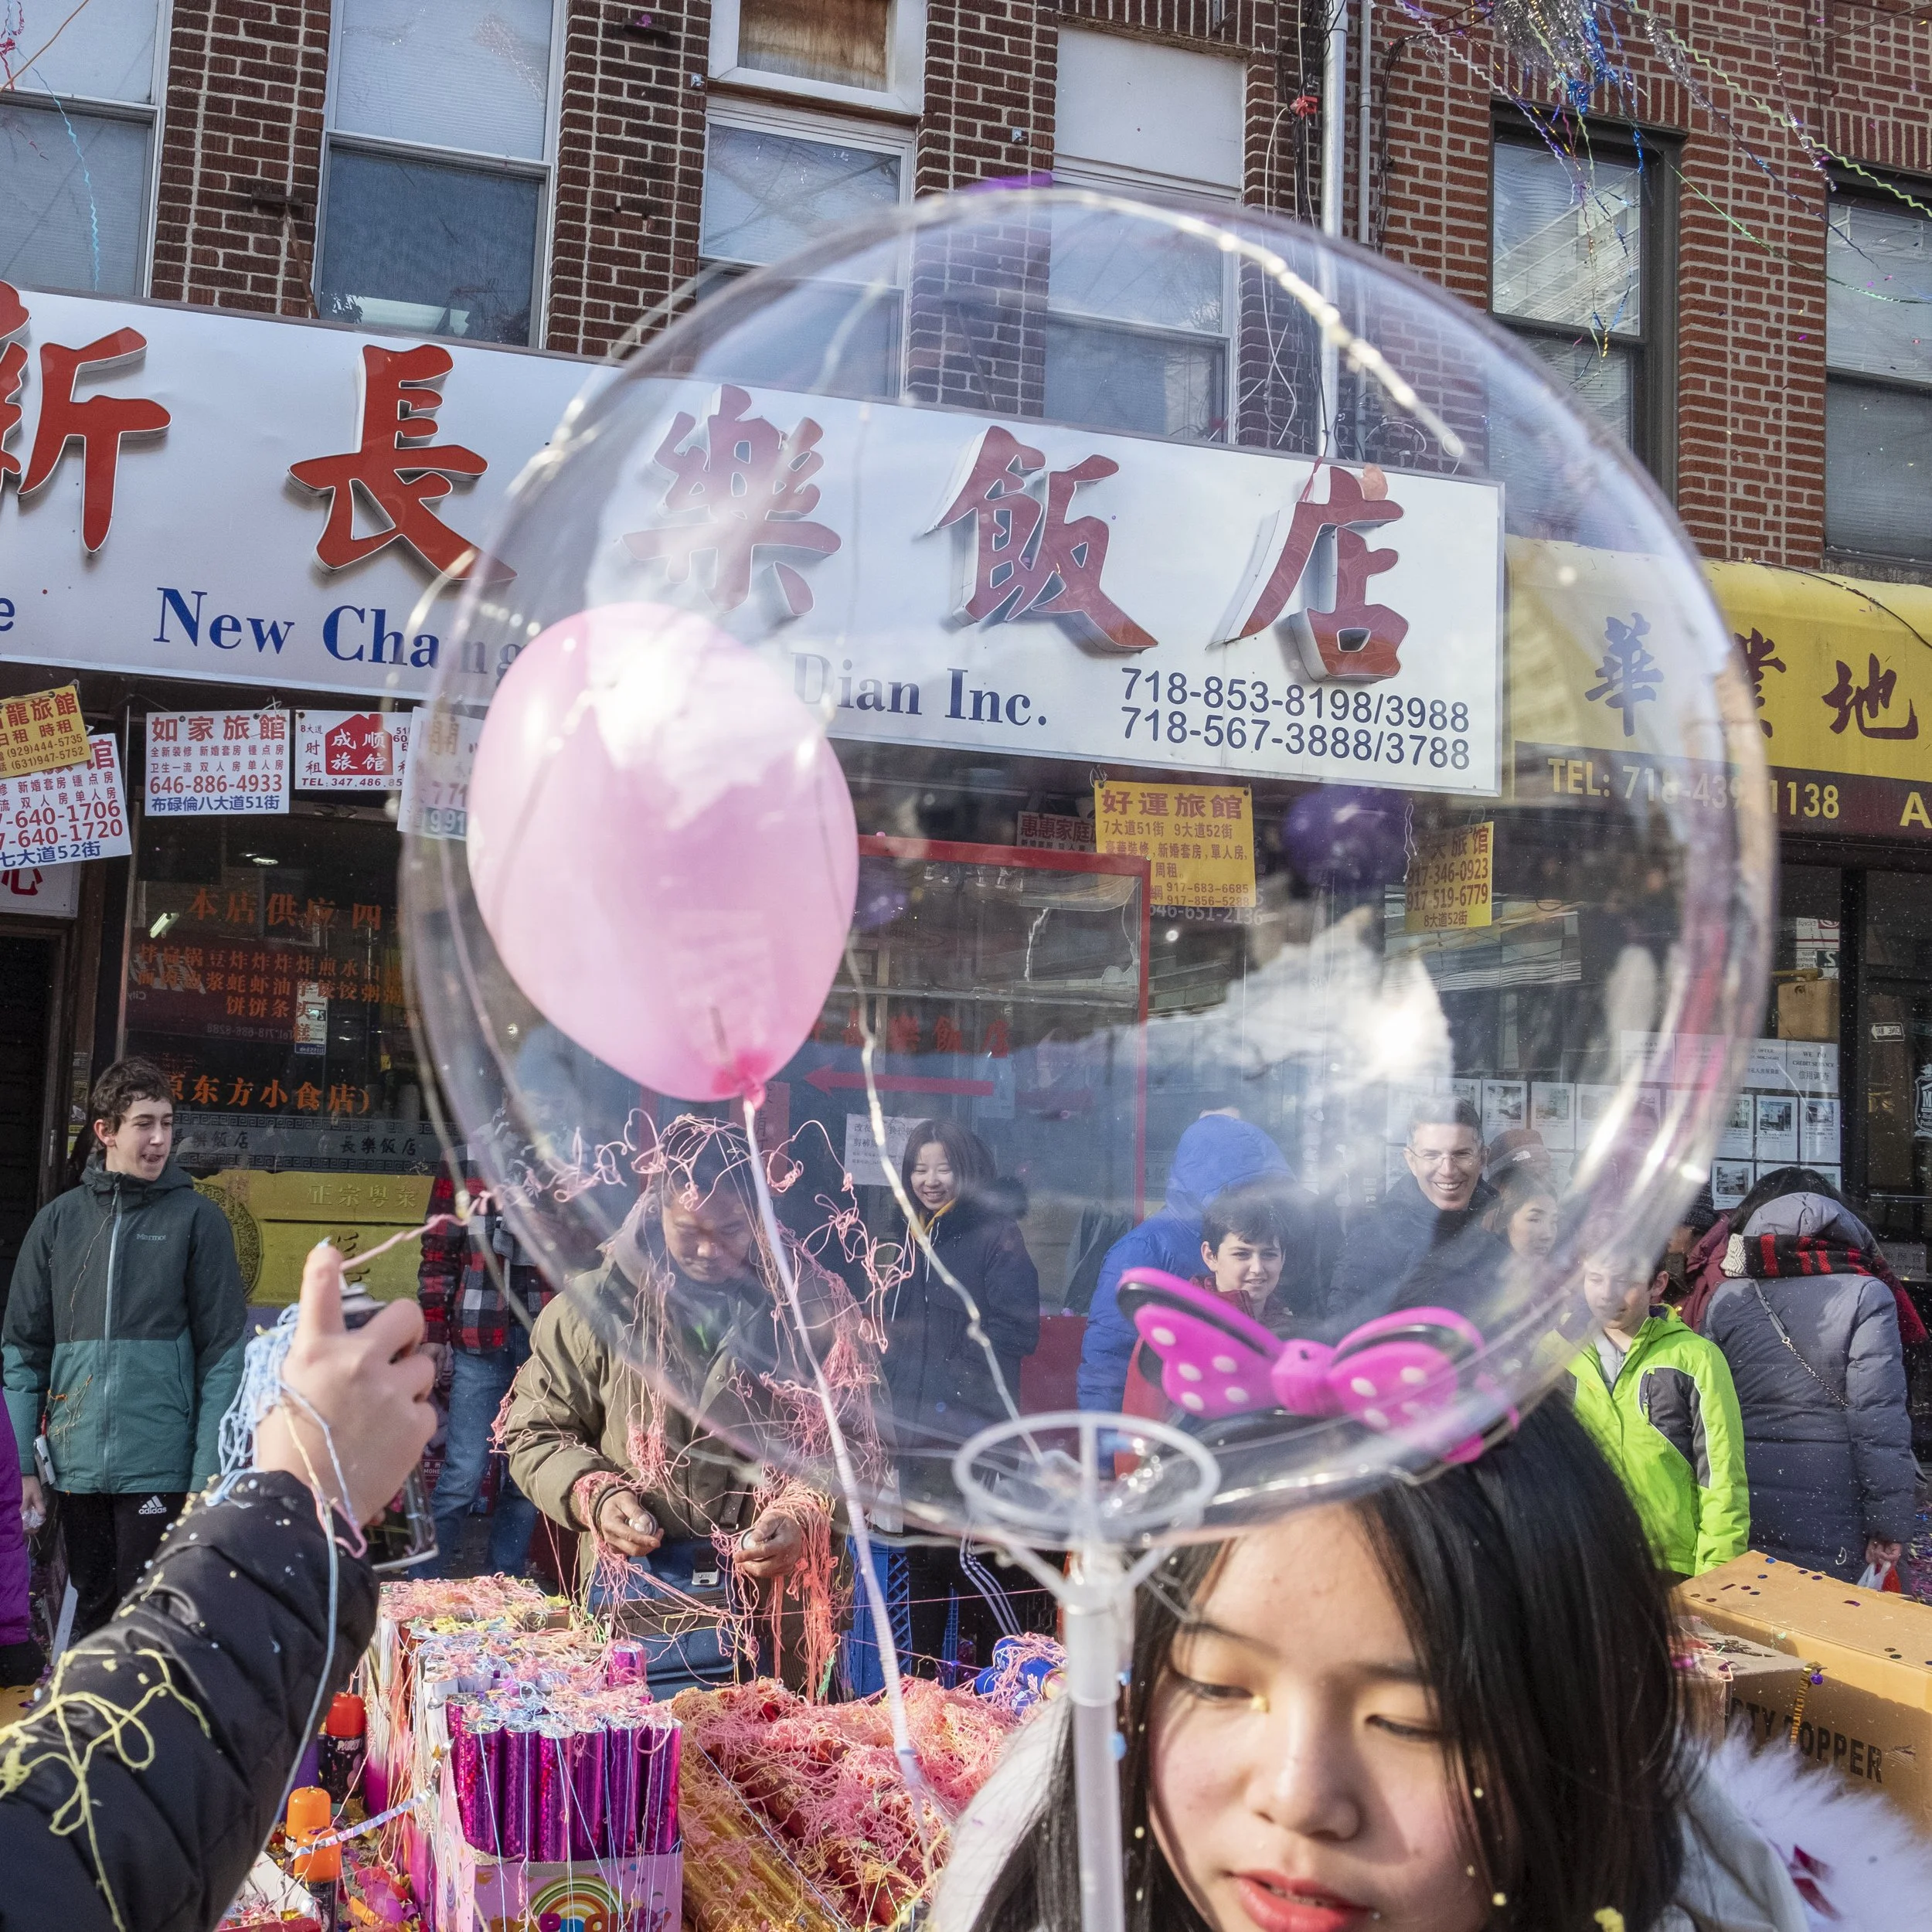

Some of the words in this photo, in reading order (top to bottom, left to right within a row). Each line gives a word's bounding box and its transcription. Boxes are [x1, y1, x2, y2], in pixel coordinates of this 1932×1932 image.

[154, 587, 294, 654] New
[791, 652, 922, 716] Dian
[944, 668, 1046, 726] Inc.
[0, 692, 78, 729] 龍旅館
[1121, 668, 1469, 733] 718-853-8198/3988
[151, 714, 287, 743] 如家旅館
[396, 726, 411, 735] 51
[1121, 706, 1470, 770] 718-567-3888/3788
[7, 734, 83, 759] (929)444-5735
[12, 747, 84, 770] (631)947-5752
[150, 774, 282, 794] 646-886-4933
[1548, 758, 1610, 798] TEL:
[0, 800, 121, 828] -640-1706
[1101, 790, 1243, 820] 好運旅館
[1103, 820, 1165, 838] 7大道51街
[1174, 825, 1233, 840] 9大道52街
[1406, 857, 1488, 887] 917-346-0923
[1166, 882, 1249, 894] 917-683-6685
[1406, 883, 1488, 912] 917-519-6779
[138, 1506, 167, 1515] adidas
